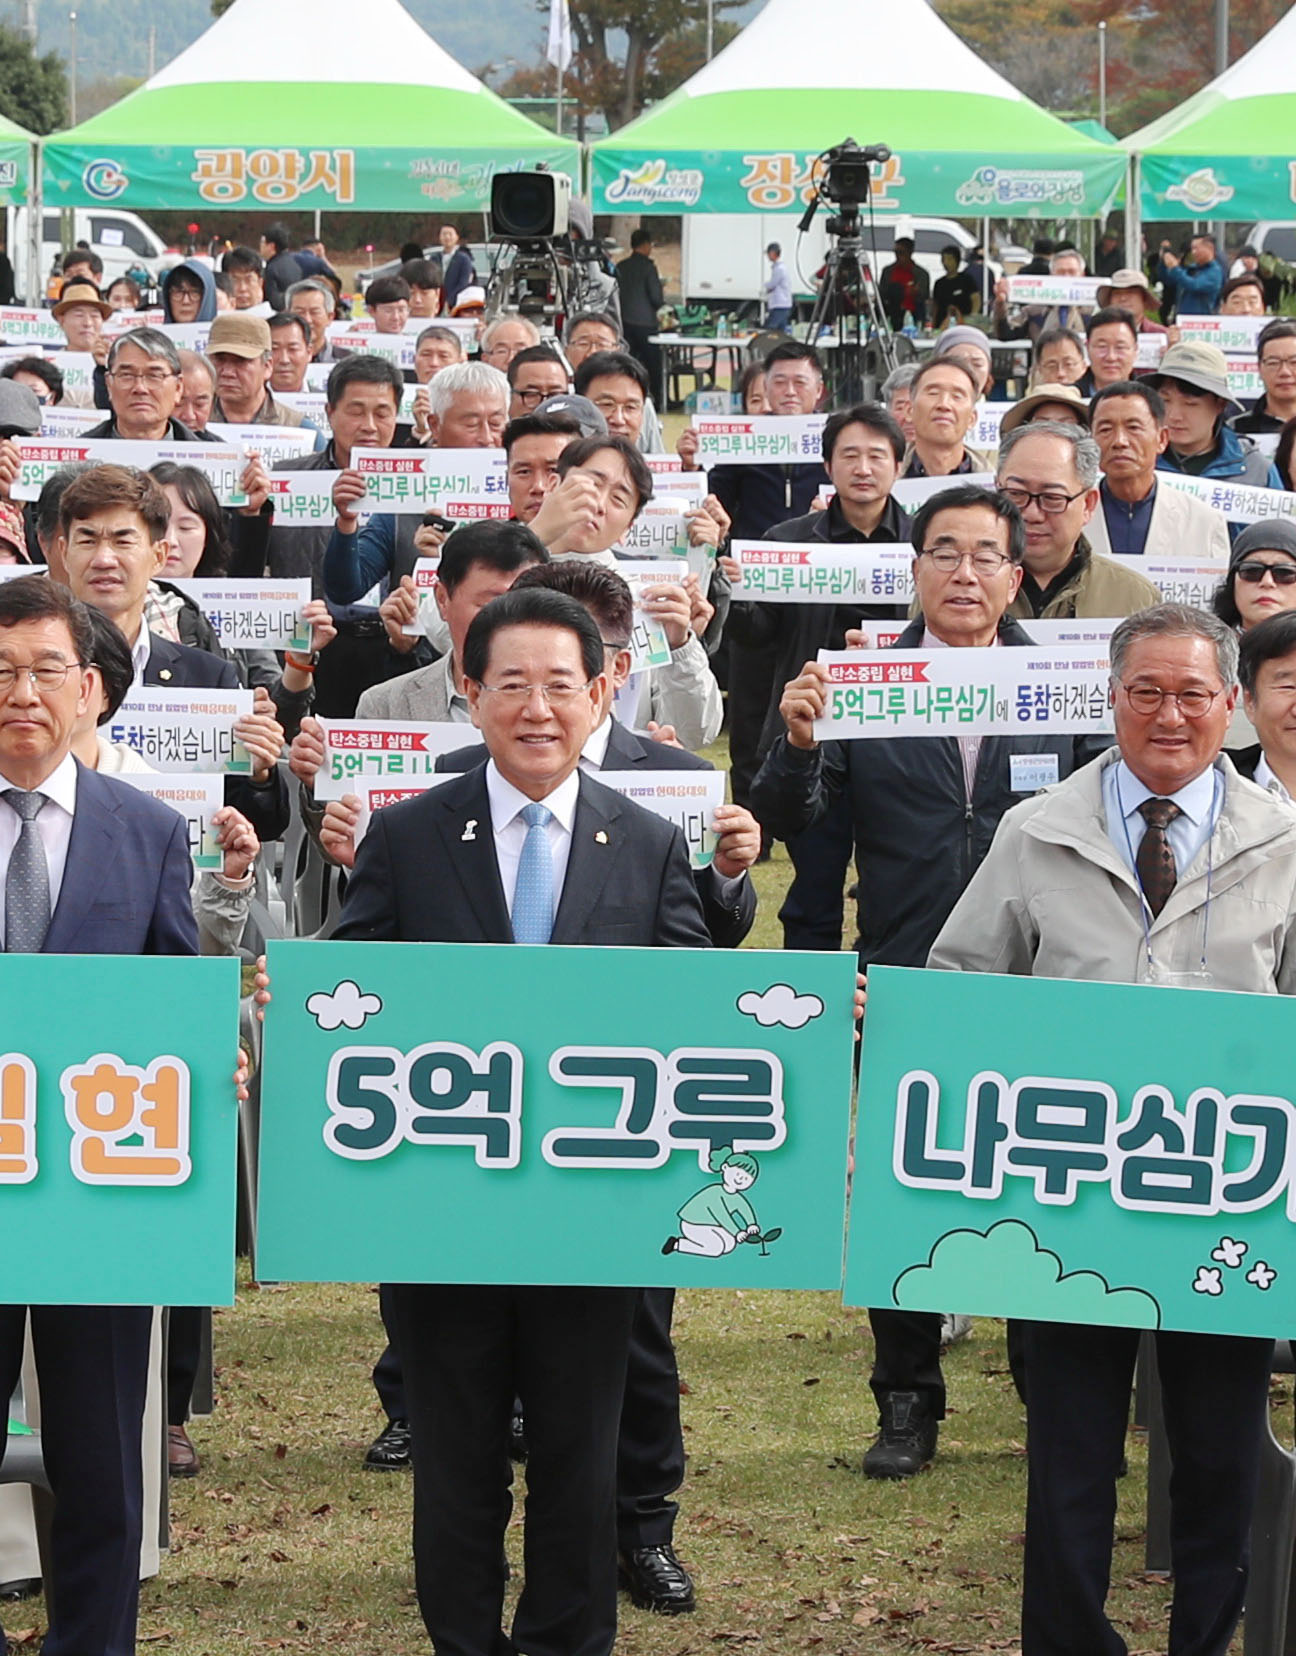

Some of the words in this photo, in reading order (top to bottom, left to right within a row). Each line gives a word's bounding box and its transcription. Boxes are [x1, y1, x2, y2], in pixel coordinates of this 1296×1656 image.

[192, 148, 356, 205] 광양시
[361, 476, 409, 503] 억그루
[1211, 486, 1296, 516] 동참하겠습니다
[280, 491, 336, 518] 나무심기
[625, 522, 680, 549] 겠습니다
[742, 567, 796, 596] 5억그루
[208, 611, 299, 641] 참하겠습니다
[829, 664, 886, 682] 탄소중립
[886, 664, 915, 681] 실현
[831, 683, 906, 725] 5억그루
[913, 681, 1008, 723] 나무심기에
[1016, 681, 1115, 721] 동참하겠습
[328, 731, 380, 748] 탄소중립
[382, 733, 413, 749] 실현
[325, 1042, 523, 1169] 5억
[541, 1045, 788, 1172] 그루
